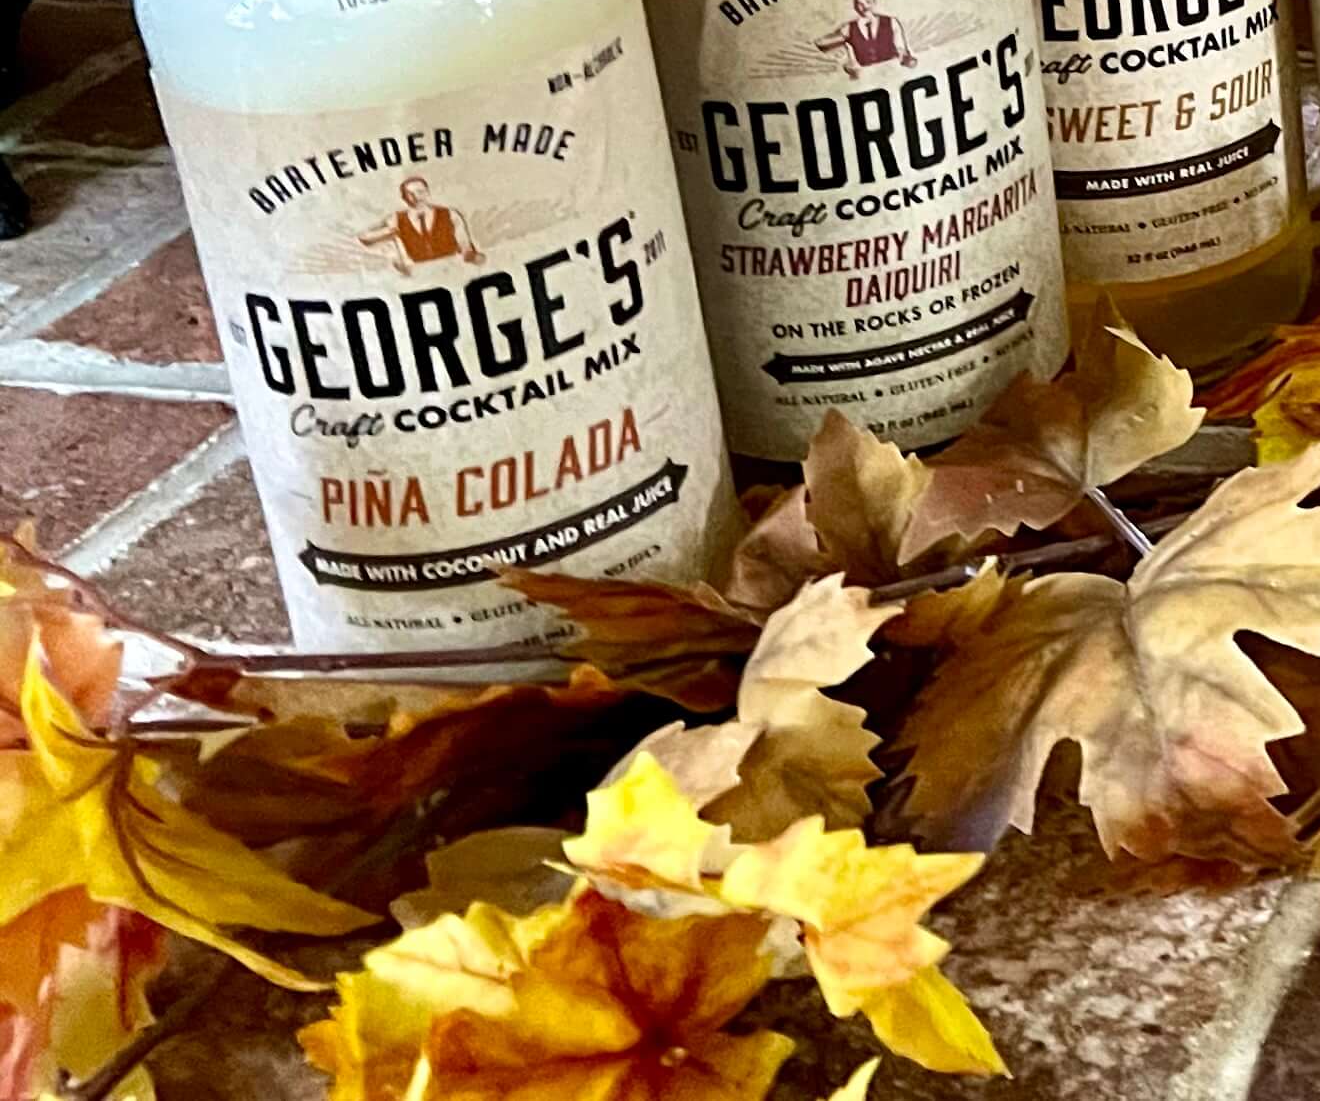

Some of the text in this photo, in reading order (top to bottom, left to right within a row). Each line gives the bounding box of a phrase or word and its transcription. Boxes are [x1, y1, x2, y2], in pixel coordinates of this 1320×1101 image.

[1100, 0, 1280, 75] COCKTAIL MIX
[701, 32, 1027, 194] GEORGE'S
[1176, 92, 1196, 130] &
[1210, 59, 1273, 121] SOUR
[250, 122, 576, 216] BARTENDER MADE
[738, 135, 1025, 239] Craft COCKTAIL MIX
[1086, 178, 1129, 191] MADE
[1134, 172, 1175, 187] WITH
[1179, 163, 1214, 179] REAL
[720, 176, 1038, 277] STRAWBERRY MARGARITA
[245, 216, 644, 400] GEORGE'S
[772, 261, 1022, 339] ON THE ROCKS OR FROZEN
[846, 250, 961, 308] DAIQUIRI
[290, 332, 641, 448] Craft COCKTAIL MIX
[320, 408, 641, 527] PIÑA COLADA
[314, 556, 362, 581] MADE
[364, 563, 419, 583] WITH
[534, 527, 578, 556] AND
[583, 507, 629, 536] REAL
[631, 475, 674, 513] JUICE
